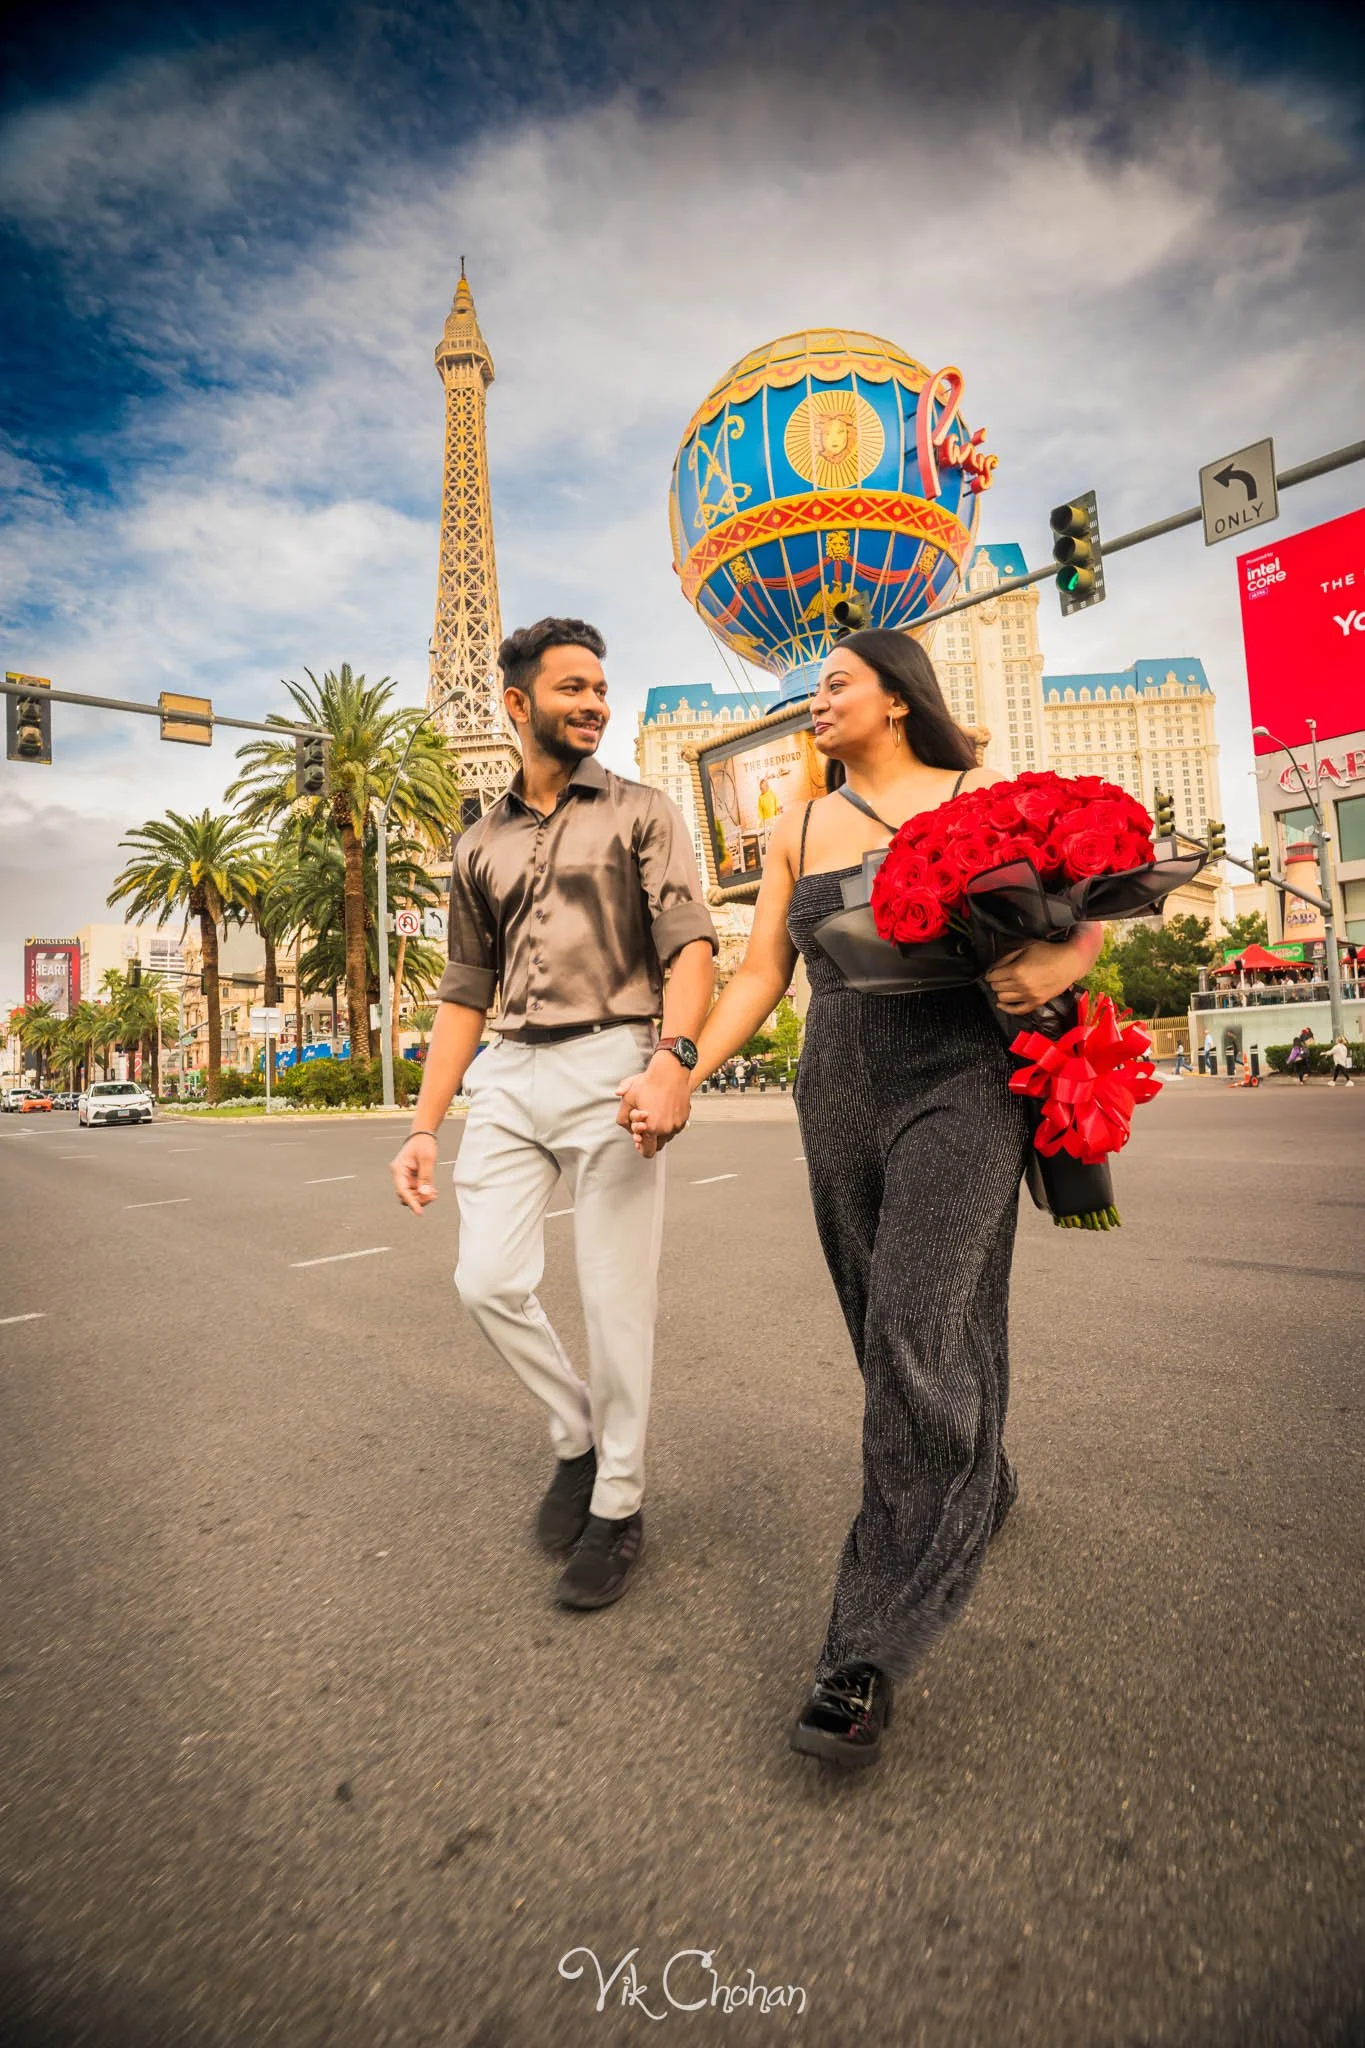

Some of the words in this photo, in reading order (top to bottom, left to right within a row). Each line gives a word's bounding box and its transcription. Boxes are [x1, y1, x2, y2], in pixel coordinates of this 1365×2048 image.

[916, 366, 999, 501] Paris
[1214, 501, 1264, 534] ONLY
[1246, 557, 1280, 581] intel
[1320, 572, 1355, 593] THE
[743, 759, 761, 773] THE
